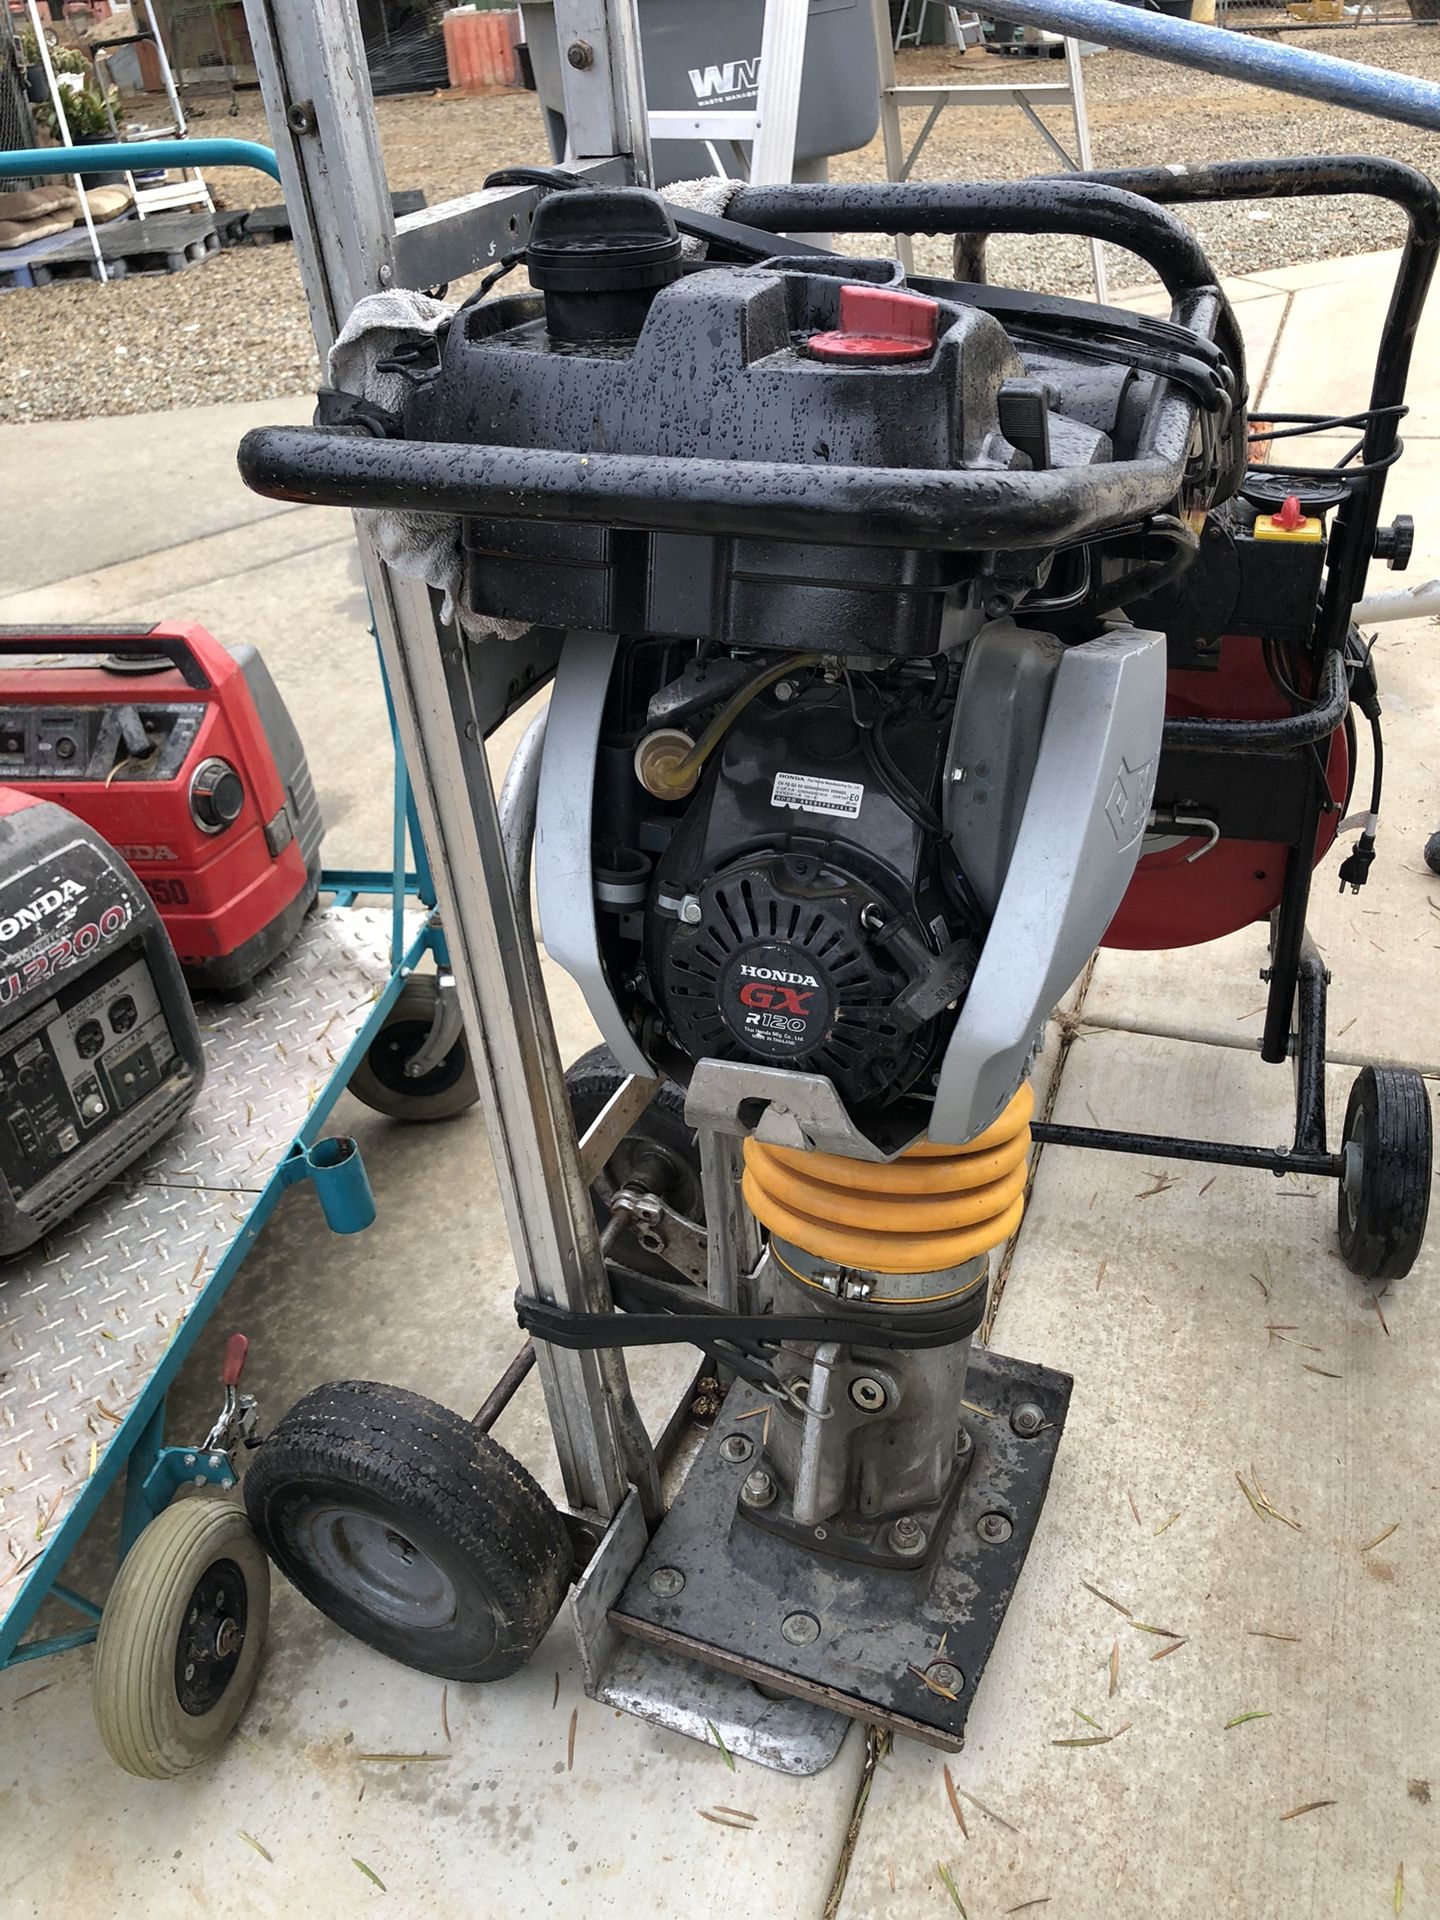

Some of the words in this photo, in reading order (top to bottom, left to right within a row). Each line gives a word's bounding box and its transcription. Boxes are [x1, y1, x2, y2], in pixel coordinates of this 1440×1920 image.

[113, 846, 178, 861] NDA
[0, 879, 87, 942] ONDA
[0, 901, 133, 1008] U2200i
[740, 964, 819, 987] HONDA
[739, 982, 815, 1015] GX
[745, 1012, 806, 1032] R120
[772, 1037, 795, 1045] THAILAND
